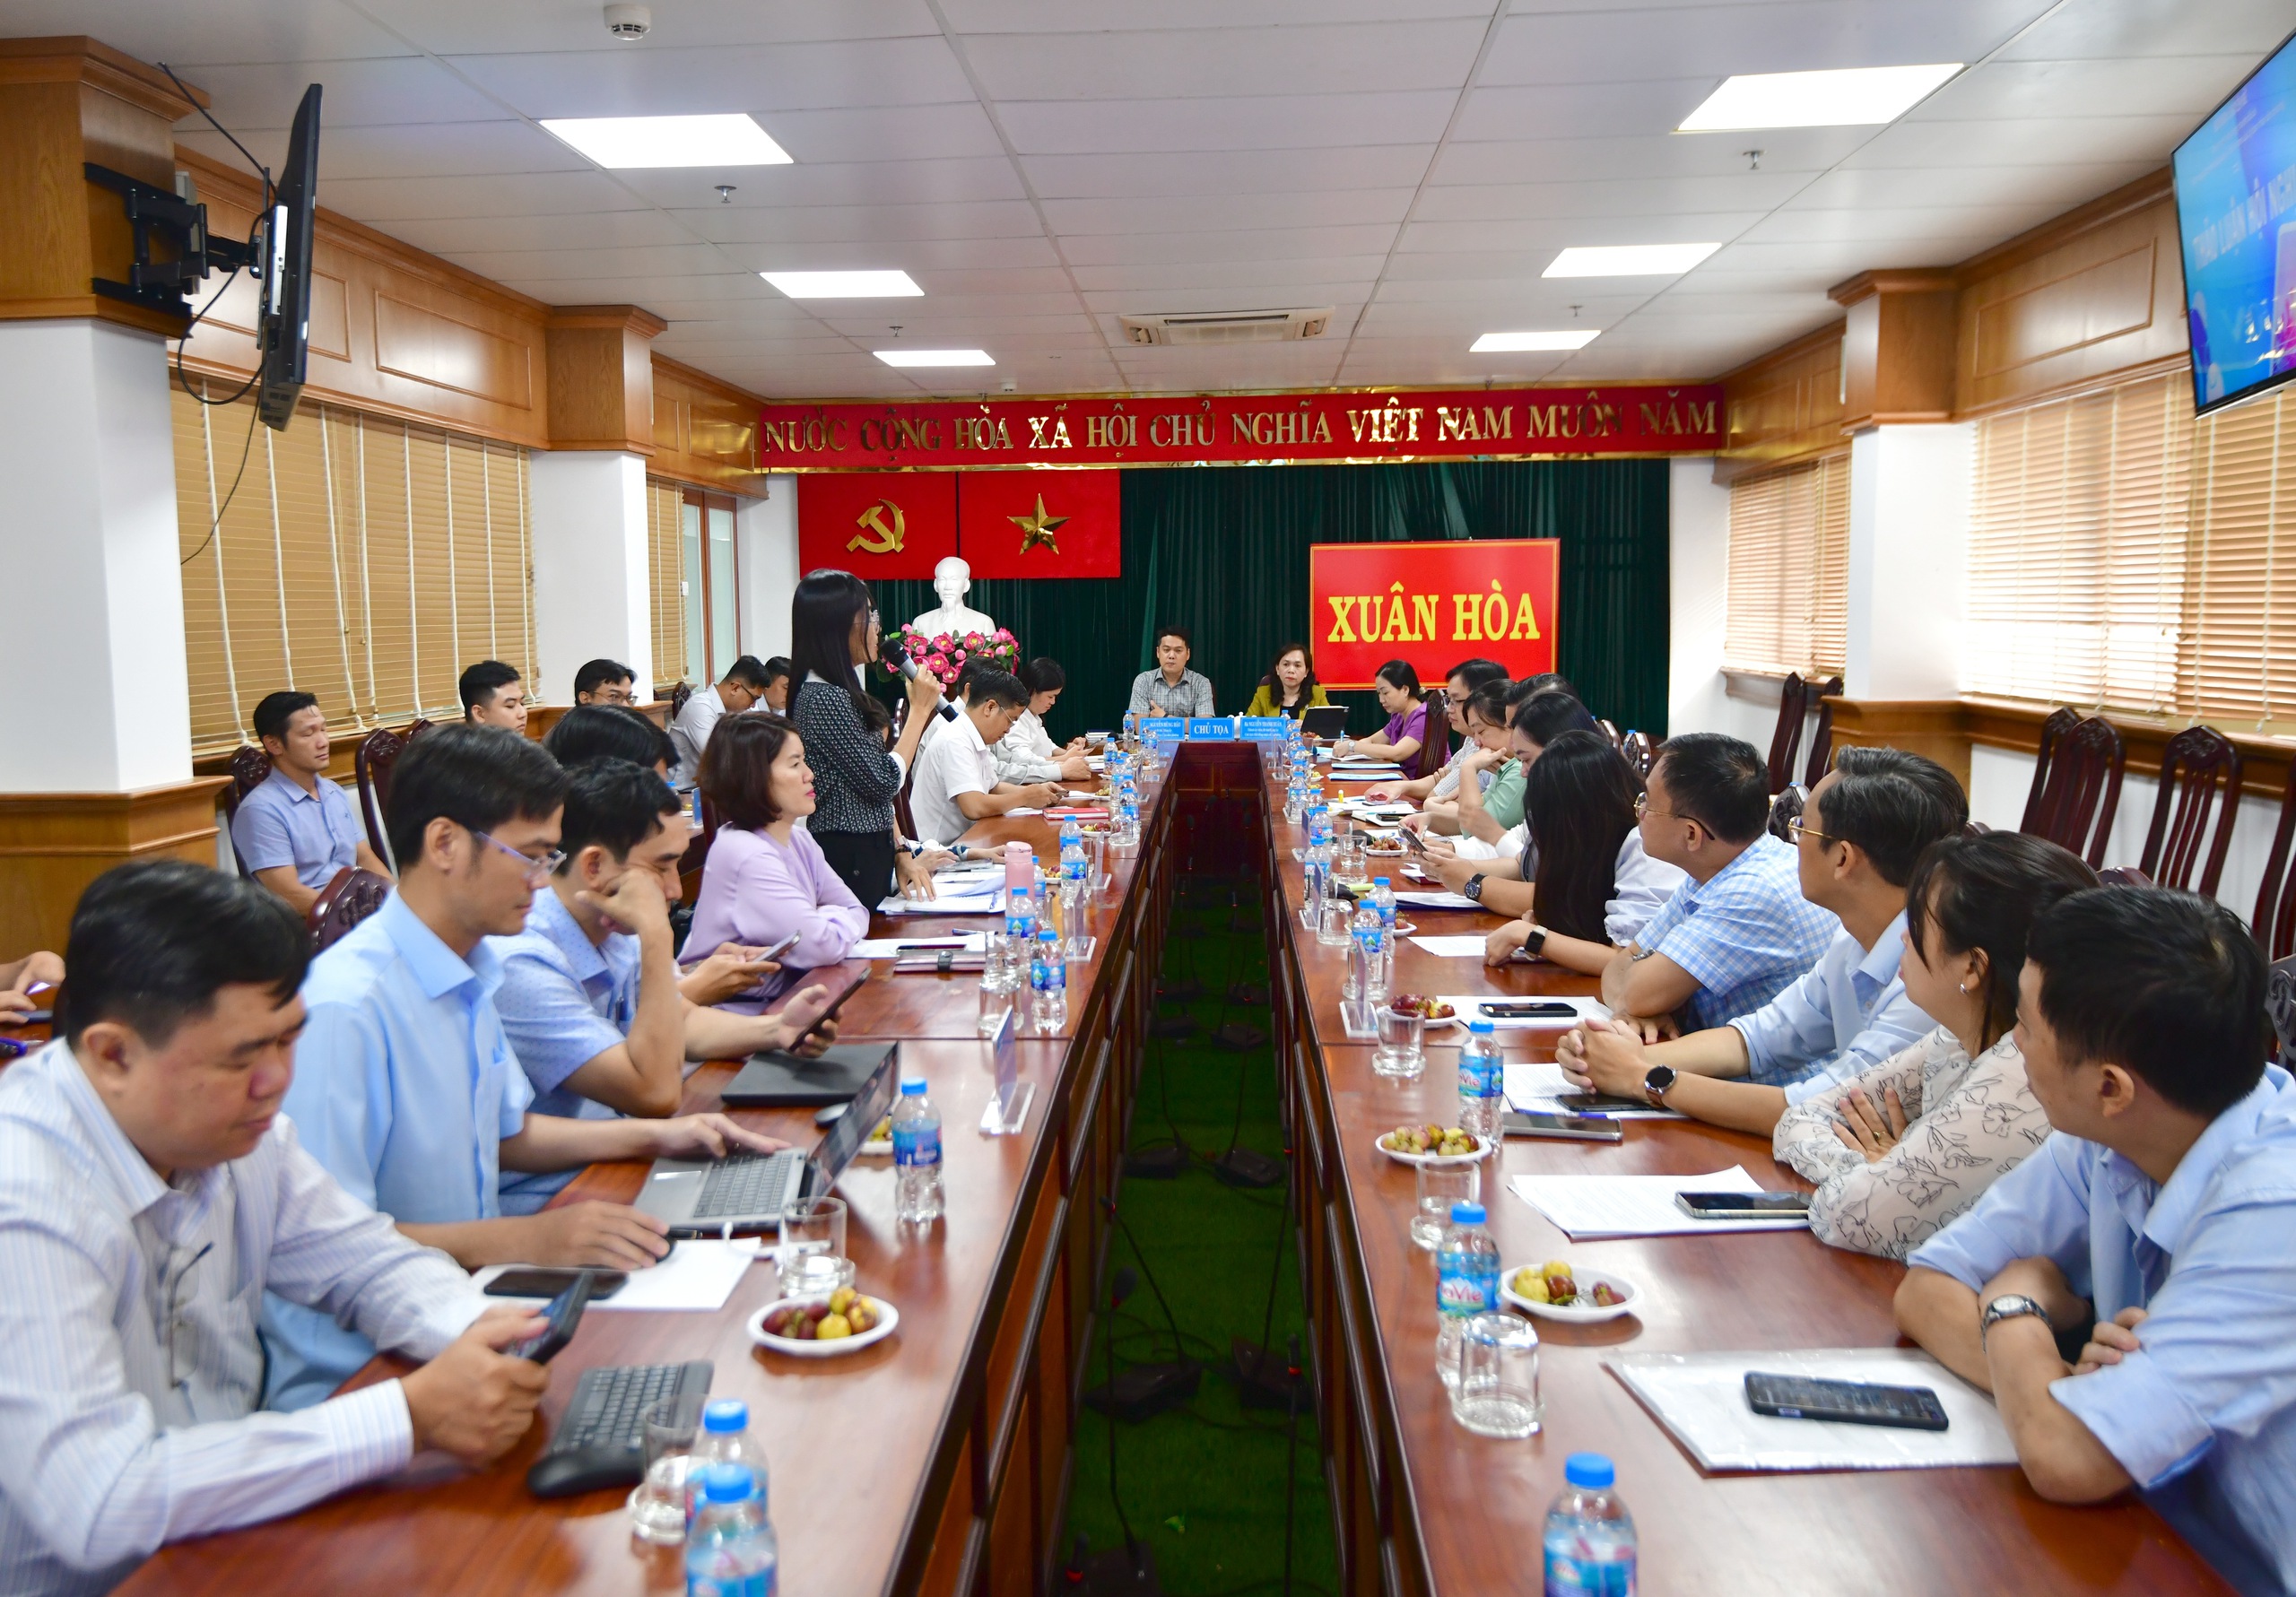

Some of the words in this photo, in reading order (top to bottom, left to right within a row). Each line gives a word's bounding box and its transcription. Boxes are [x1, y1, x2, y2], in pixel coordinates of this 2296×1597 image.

[764, 404, 848, 453] NƯỚC
[859, 407, 942, 461] CỘNG
[953, 404, 1013, 450] HÒA
[1027, 403, 1074, 449] XÃ
[1086, 402, 1139, 458] HỘI
[1150, 399, 1217, 447] CHỦ
[1231, 399, 1334, 446] NGHĨA
[1345, 395, 1424, 452] VIỆT
[1437, 404, 1514, 442] NAM
[1526, 389, 1624, 439] MUÔN
[1639, 387, 1718, 436] NĂM
[1327, 580, 1439, 644] XUÂN
[1452, 578, 1541, 641] HÒA
[1194, 721, 1212, 734] CHỦ
[1213, 725, 1230, 736] TỌA
